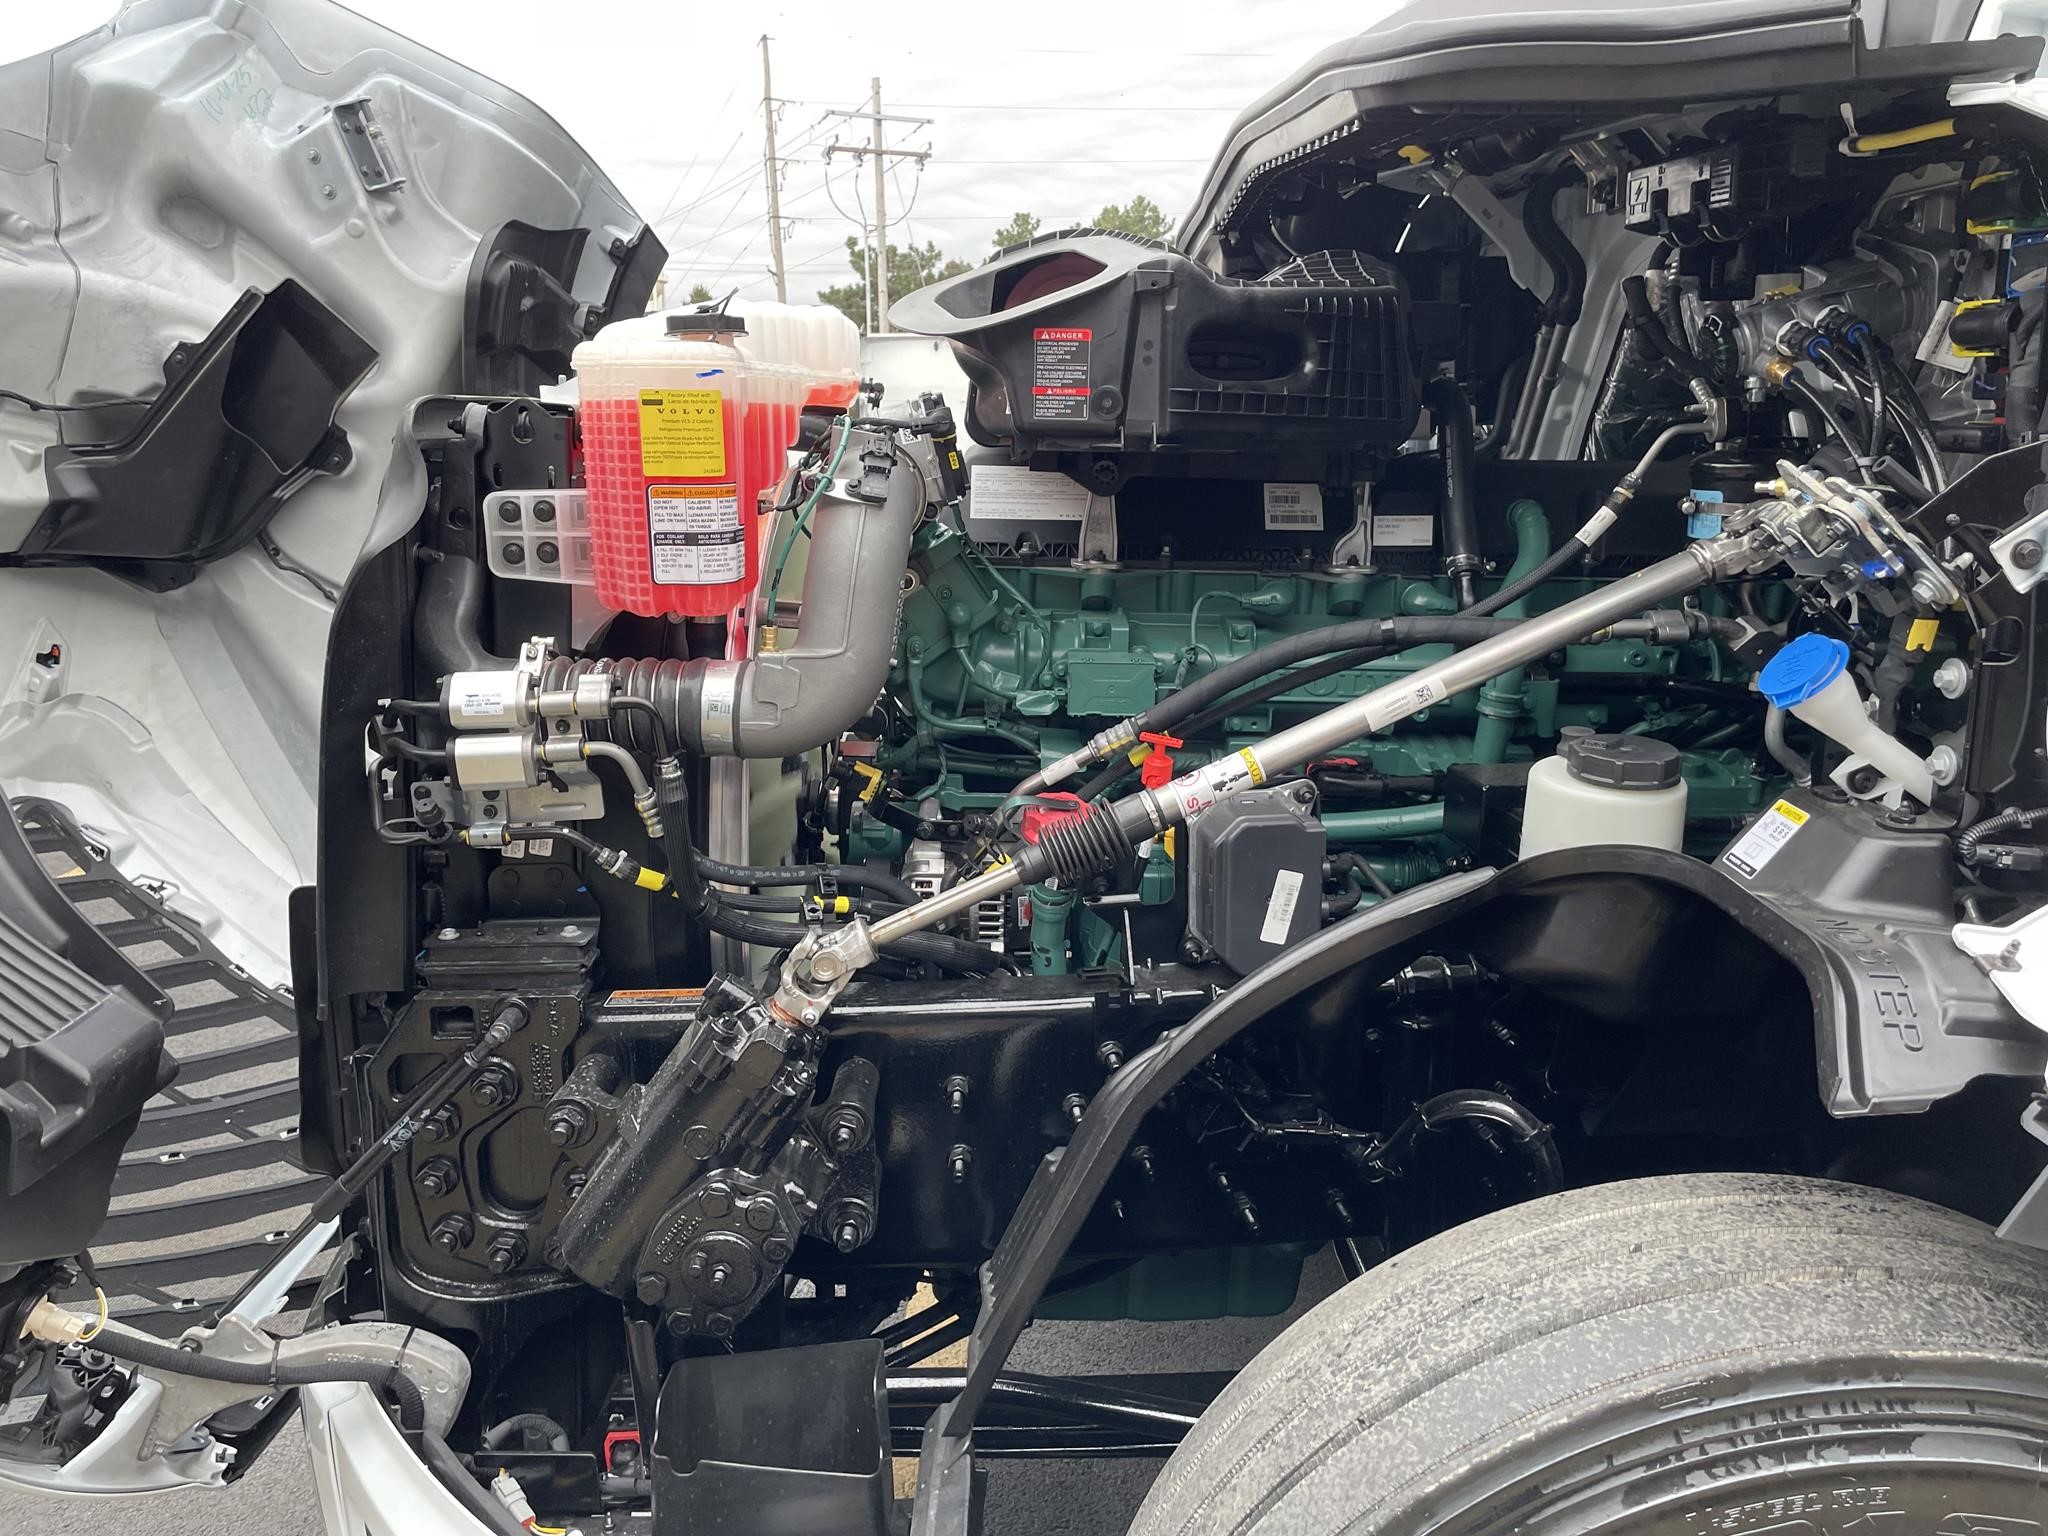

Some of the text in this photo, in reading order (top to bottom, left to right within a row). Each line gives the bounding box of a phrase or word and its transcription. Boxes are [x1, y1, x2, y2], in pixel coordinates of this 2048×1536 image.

[1773, 826, 1790, 839] SRS
[1815, 919, 1924, 1052] NO STEP
